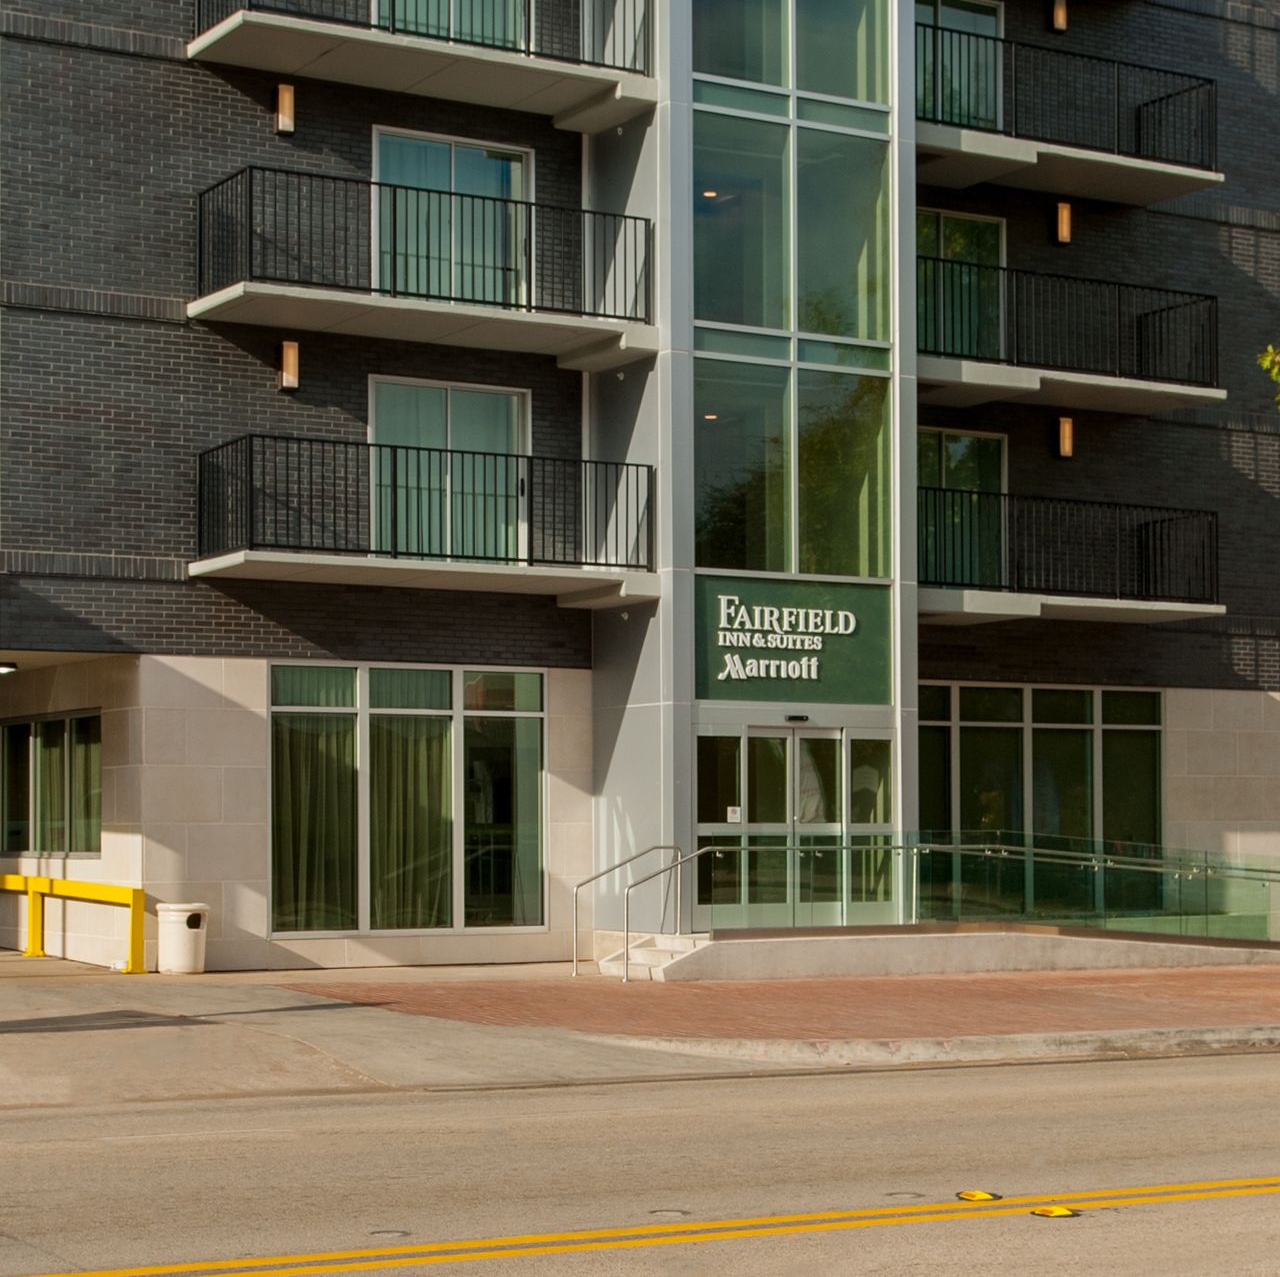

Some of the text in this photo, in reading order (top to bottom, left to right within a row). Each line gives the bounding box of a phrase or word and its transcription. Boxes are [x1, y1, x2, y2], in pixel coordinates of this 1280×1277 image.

[717, 595, 856, 635] FAIRFIELD
[718, 631, 823, 650] INN & SUITES
[717, 653, 819, 681] Marriott
